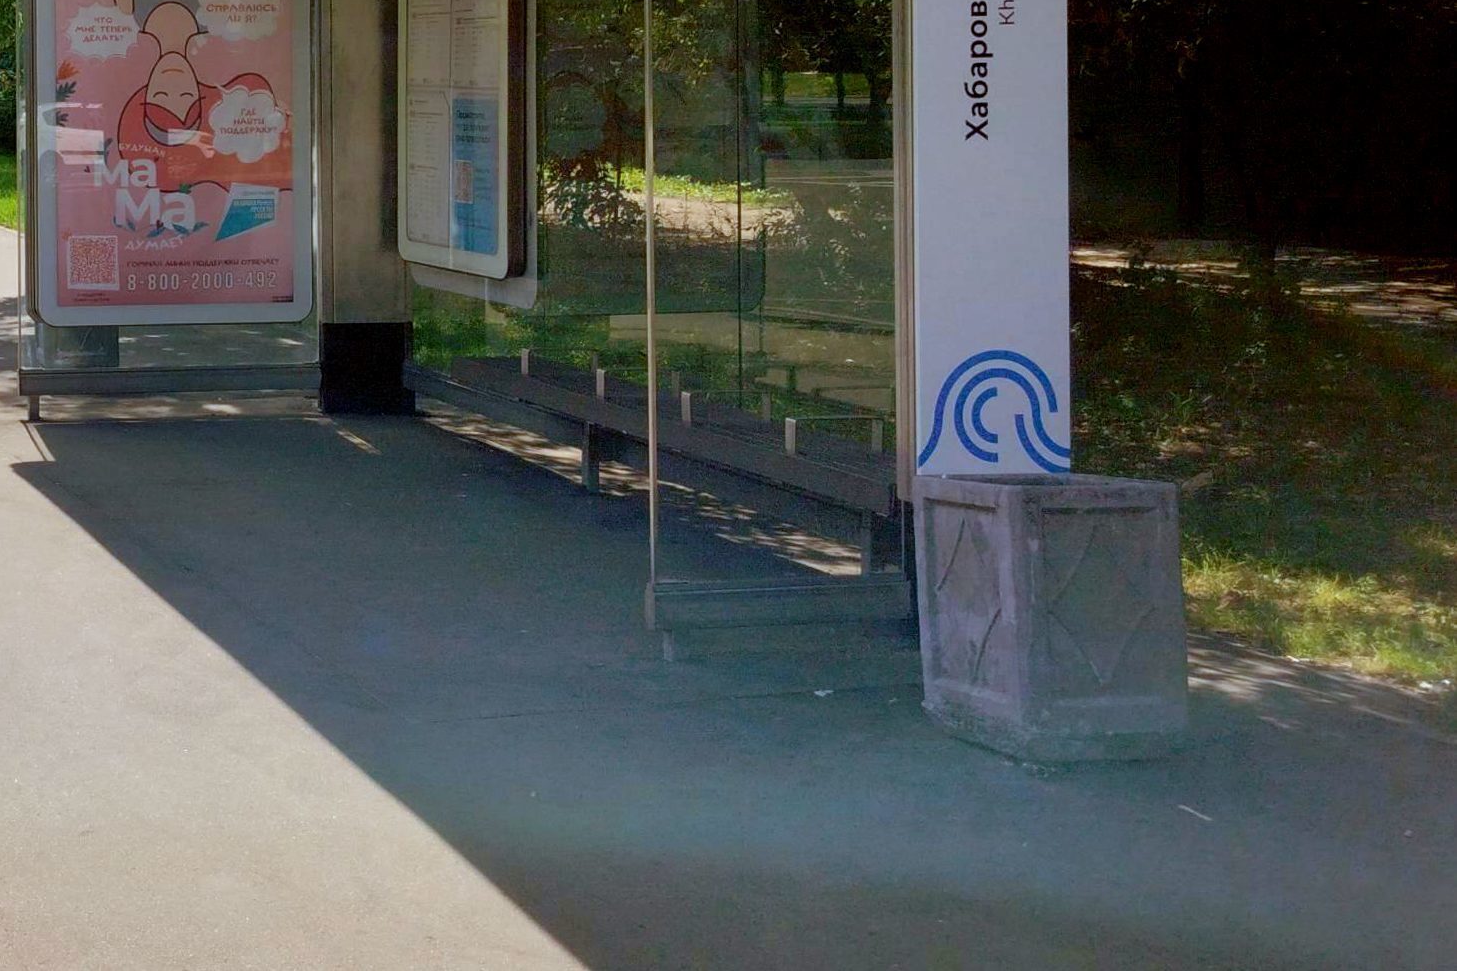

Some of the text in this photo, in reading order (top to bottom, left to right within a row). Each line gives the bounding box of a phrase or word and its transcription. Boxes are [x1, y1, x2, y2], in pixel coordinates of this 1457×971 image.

[93, 16, 113, 24] ЧТО
[75, 25, 133, 33] МНЕ ТЕПЕРЬ
[82, 34, 124, 43] ДЕЛАТЬ?
[240, 107, 257, 116] ГДЕ
[125, 235, 184, 251] ДУМАЕТ
